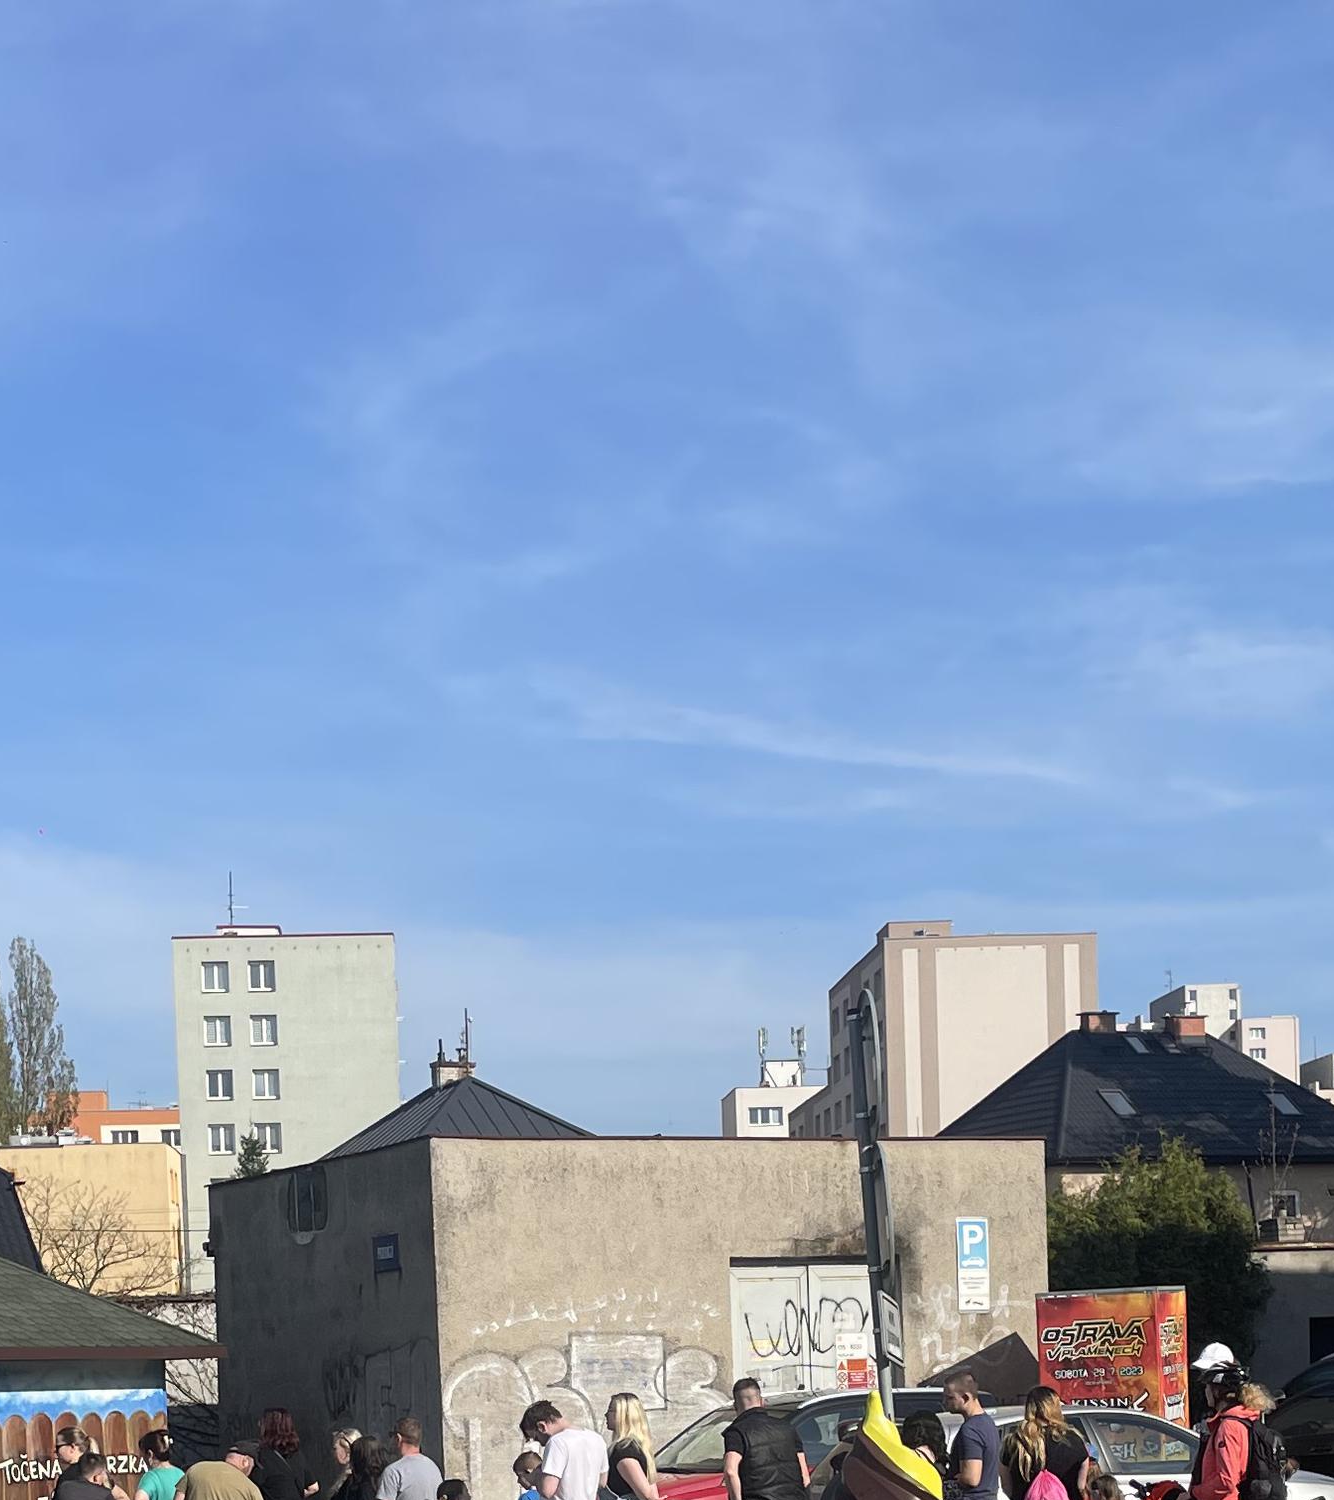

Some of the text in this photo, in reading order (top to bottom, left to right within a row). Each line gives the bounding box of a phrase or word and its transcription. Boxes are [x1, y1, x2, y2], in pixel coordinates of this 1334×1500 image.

[962, 1224, 984, 1255] P
[1041, 1316, 1152, 1348] OSTRAVA
[1054, 1368, 1089, 1380] SOBOTA
[1119, 1365, 1145, 1377] 2023
[106, 1454, 149, 1474] RZKA
